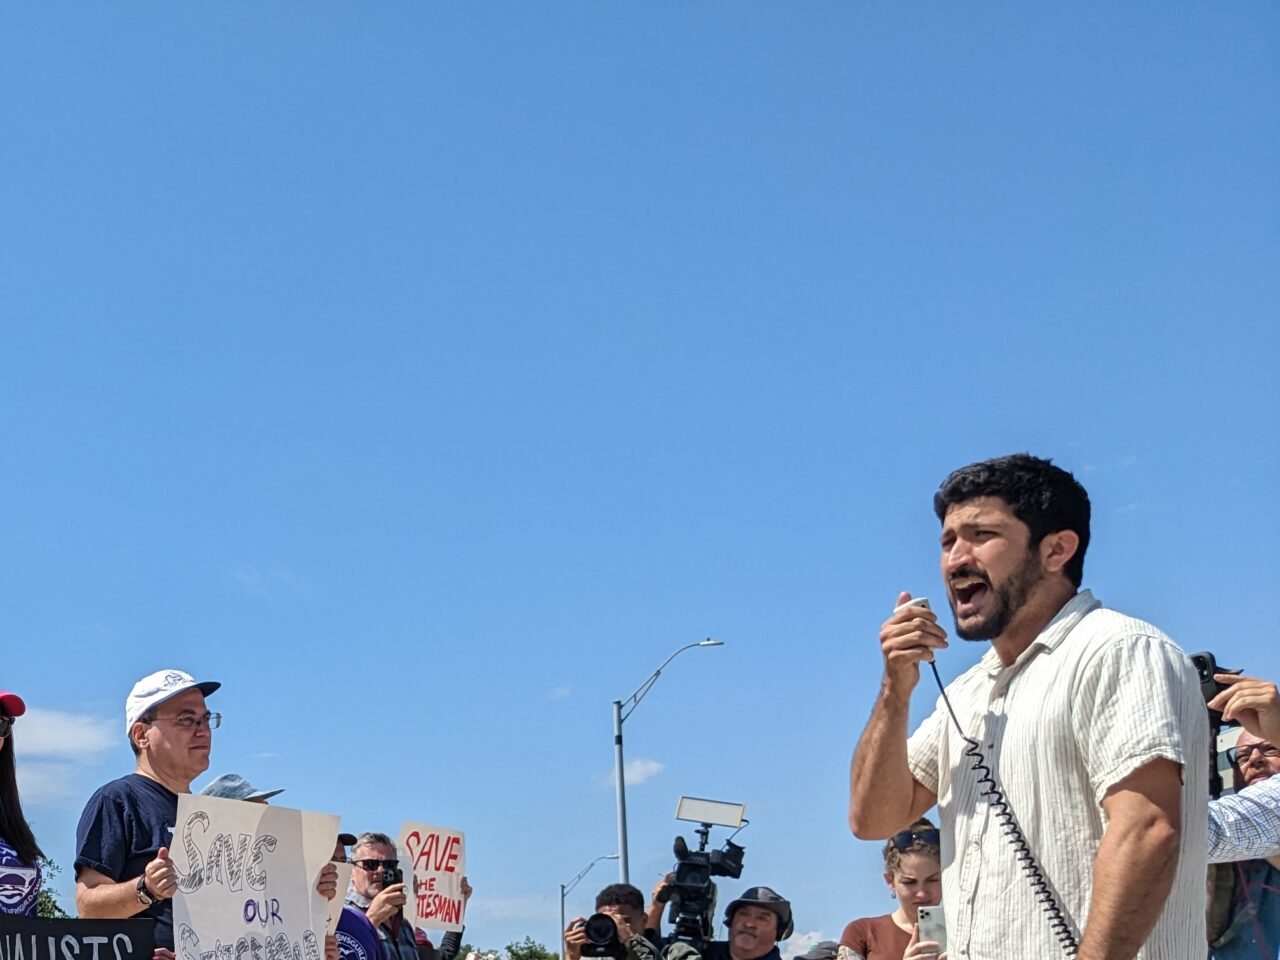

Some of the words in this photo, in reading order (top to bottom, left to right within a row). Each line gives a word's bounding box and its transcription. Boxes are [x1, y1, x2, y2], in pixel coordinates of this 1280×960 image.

[173, 811, 277, 894] SAVE
[406, 831, 461, 873] SAVE
[417, 878, 437, 891] HE
[243, 899, 283, 928] OUR
[416, 894, 462, 925] TESMAN
